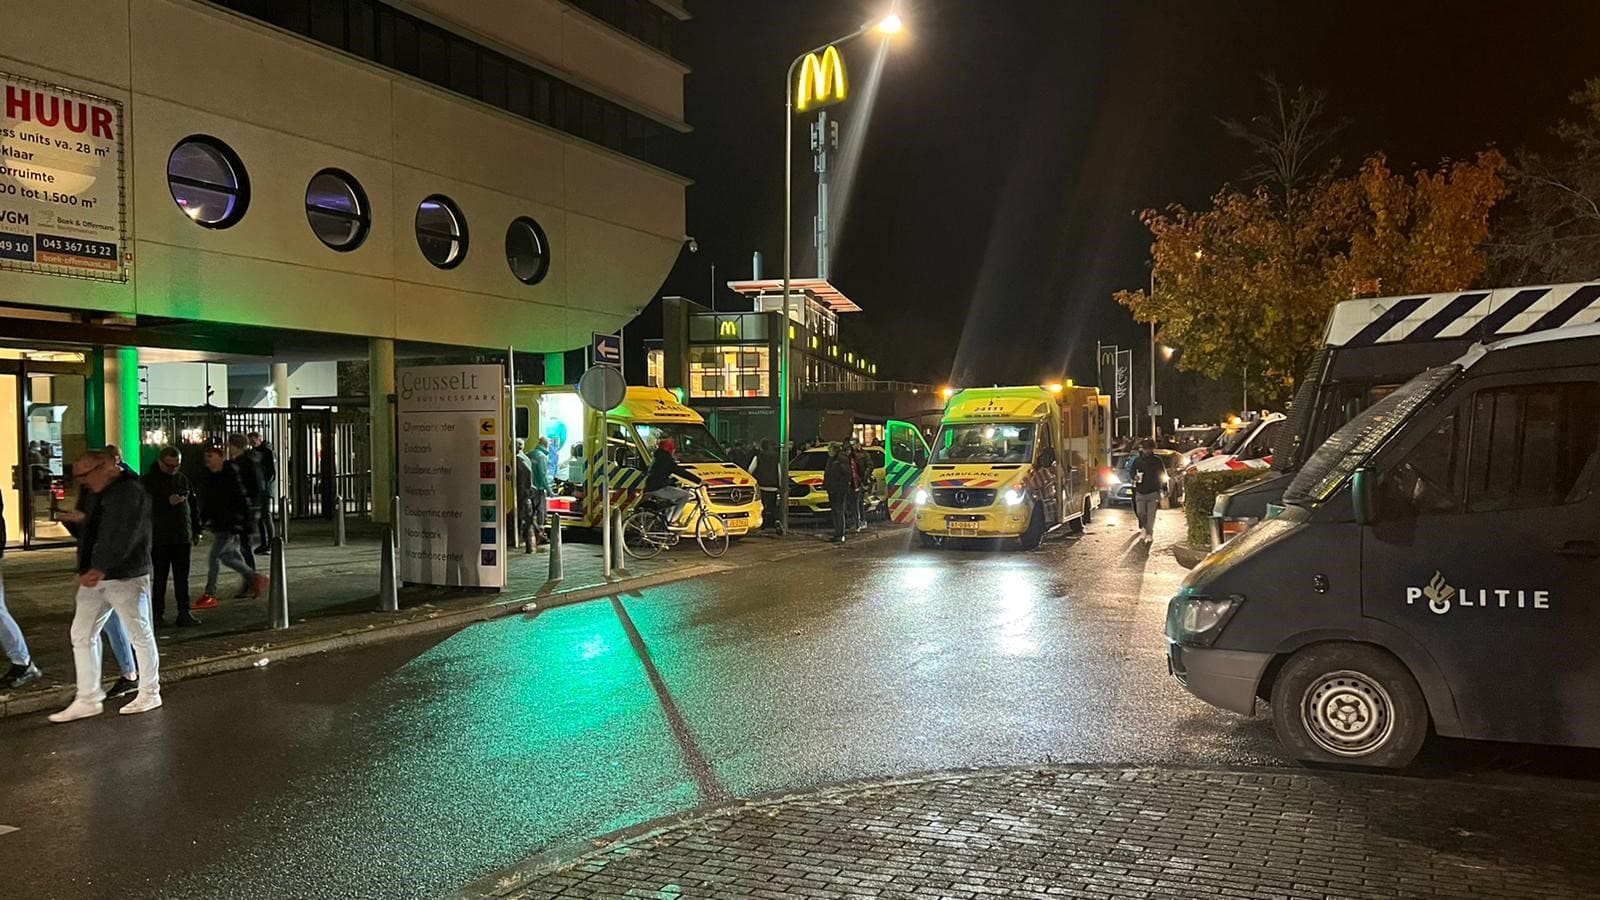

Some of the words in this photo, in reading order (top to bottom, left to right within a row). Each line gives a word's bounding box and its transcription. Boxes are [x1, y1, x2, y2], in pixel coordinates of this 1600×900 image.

[6, 85, 114, 140] HUUR
[20, 132, 51, 146] units
[54, 139, 72, 150] va.
[76, 142, 91, 154] 28
[0, 145, 34, 160] klaar
[20, 187, 39, 199] tot
[43, 191, 77, 206] 1.500
[57, 216, 73, 226] Boek
[16, 243, 29, 253] 10
[42, 239, 62, 249] 043
[65, 241, 83, 252] 367
[85, 245, 97, 254] 15
[99, 246, 111, 256] 22
[1406, 586, 1550, 615] POLITIE
